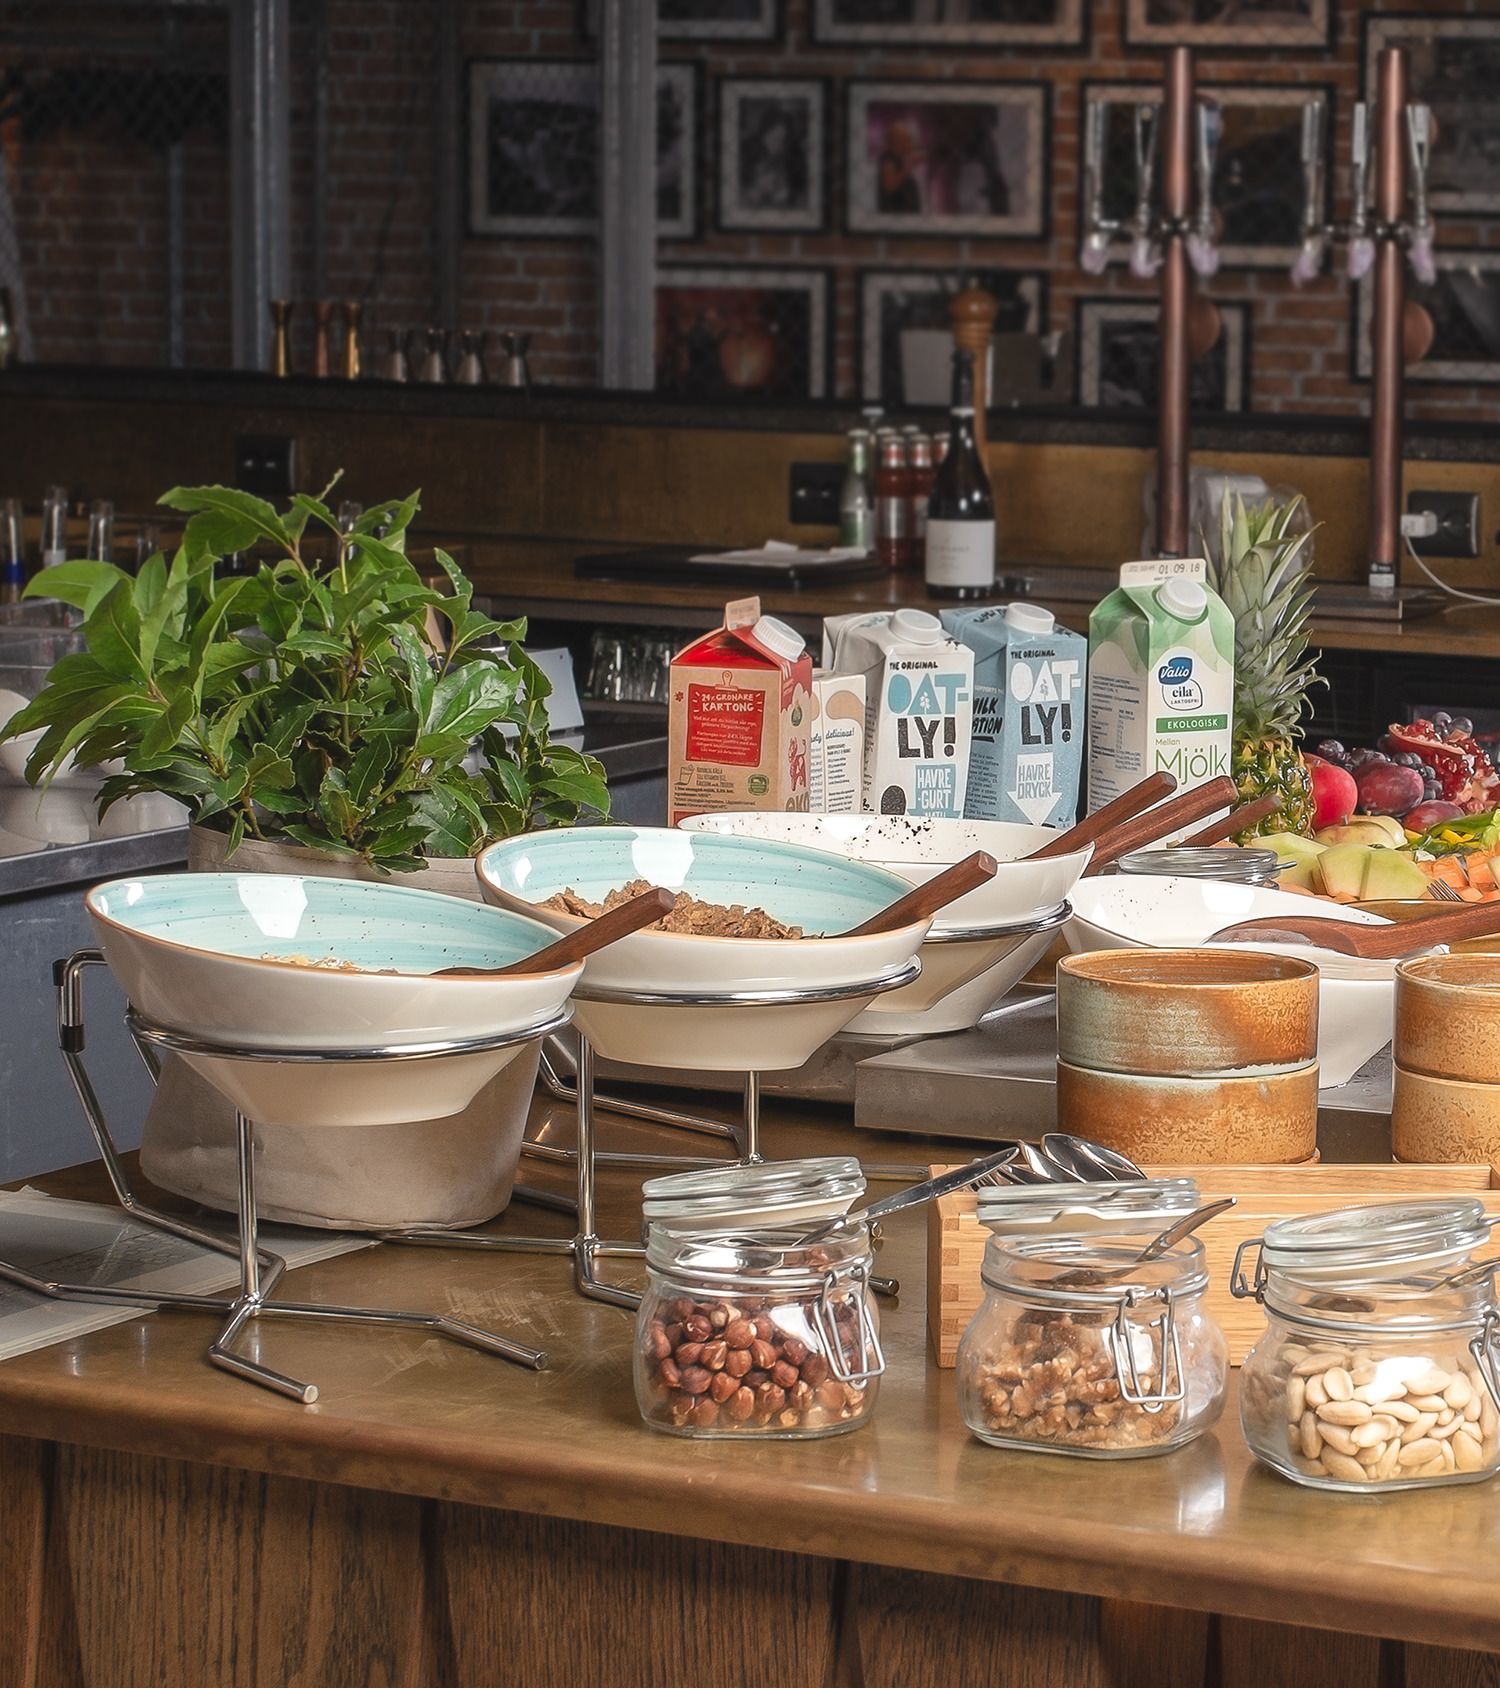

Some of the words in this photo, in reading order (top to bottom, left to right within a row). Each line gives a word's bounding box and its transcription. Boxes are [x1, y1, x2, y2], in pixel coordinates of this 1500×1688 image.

[1010, 650, 1022, 659] THE
[1023, 649, 1056, 658] ORIGINAL
[889, 661, 900, 670] THE
[901, 661, 939, 670] ORIGINAL
[1160, 666, 1190, 679] Valio
[702, 702, 755, 712] KARTONG
[1021, 703, 1072, 745] LY!
[1167, 718, 1219, 729] EKOLOGISK
[897, 716, 956, 759] LY!
[1018, 763, 1051, 782] HAVRE
[1155, 744, 1228, 786] Mjölk
[917, 768, 952, 789] HAVRE
[1017, 780, 1051, 800] DRYCK
